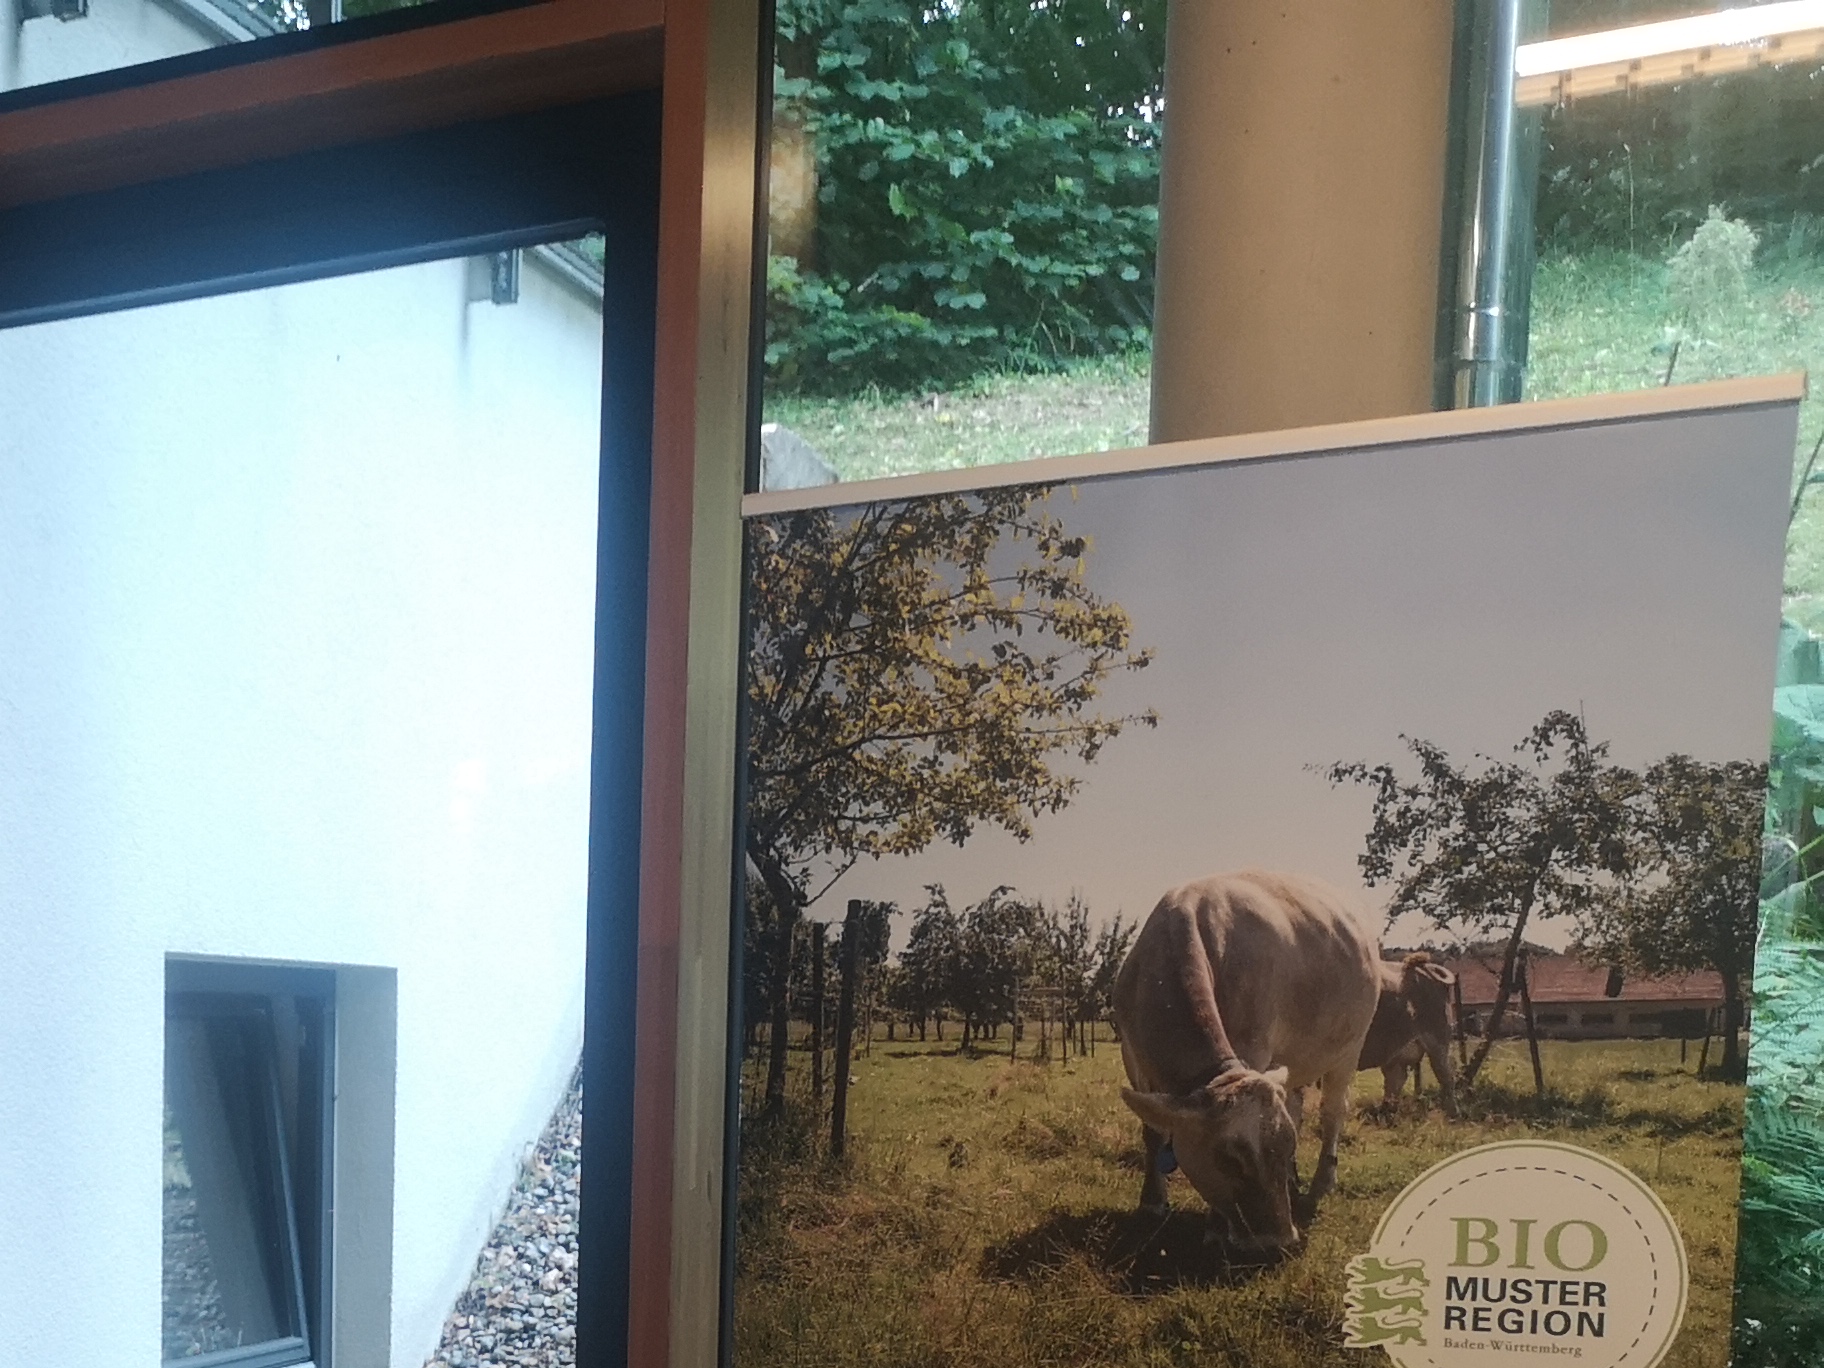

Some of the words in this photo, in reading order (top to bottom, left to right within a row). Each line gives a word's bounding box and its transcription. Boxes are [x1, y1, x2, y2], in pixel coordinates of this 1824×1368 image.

[1449, 1217, 1609, 1274] BIO
[1445, 1275, 1608, 1308] MUSTER
[1444, 1305, 1606, 1339] REGION
[1443, 1337, 1583, 1358] Baden-Württemberg
